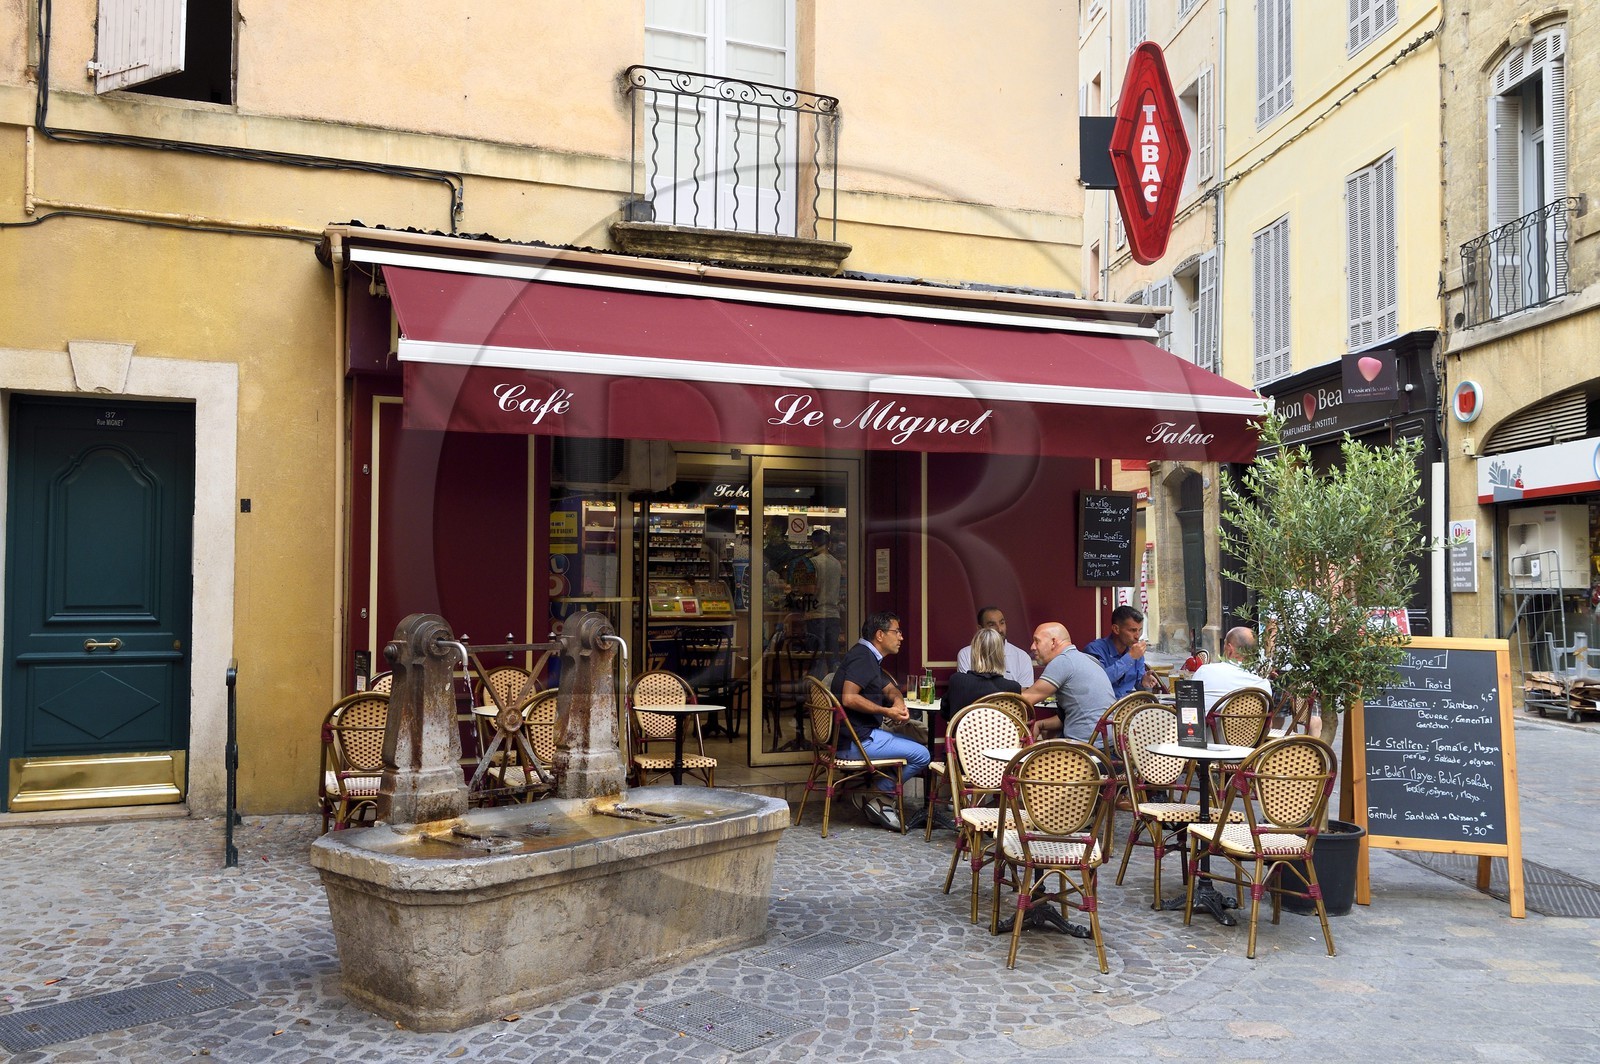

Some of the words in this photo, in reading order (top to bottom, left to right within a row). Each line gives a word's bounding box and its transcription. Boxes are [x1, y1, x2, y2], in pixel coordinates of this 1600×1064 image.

[1140, 104, 1161, 203] TABAC
[105, 411, 116, 419] 37
[493, 383, 575, 425] Café
[767, 394, 824, 427] Le
[832, 400, 993, 445] Mignet
[1145, 422, 1215, 445] Tabac
[1283, 423, 1311, 437] PARFUMERIE
[1314, 416, 1338, 428] INSTITUT
